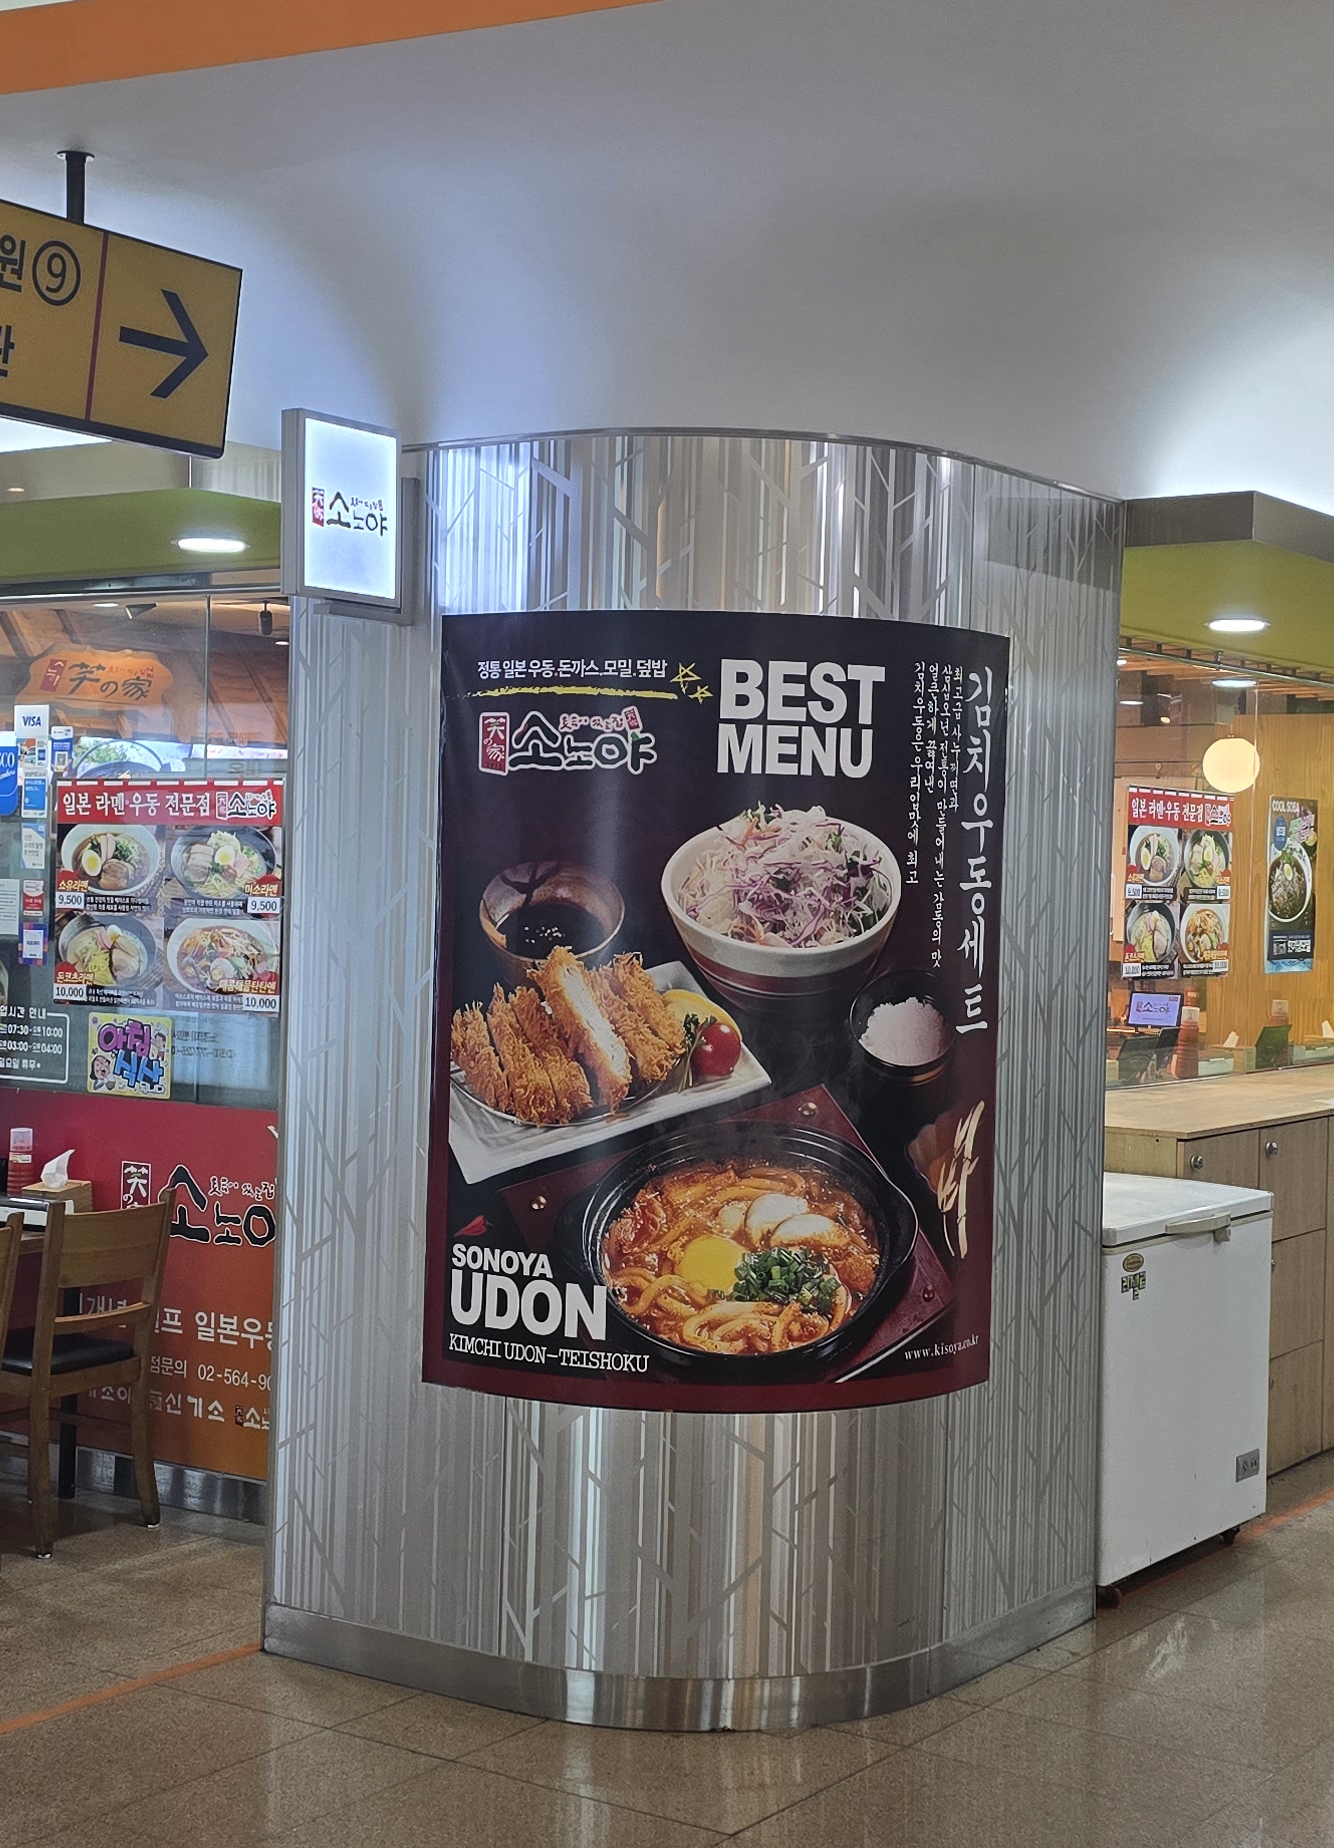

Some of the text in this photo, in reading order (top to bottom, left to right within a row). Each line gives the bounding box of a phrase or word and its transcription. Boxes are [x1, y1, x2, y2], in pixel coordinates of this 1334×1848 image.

[327, 491, 387, 537] 소노야
[478, 660, 501, 678] 정통
[503, 660, 526, 678] 일본
[720, 658, 885, 725] BEST
[22, 716, 41, 727] VISA
[509, 712, 655, 774] 소노야
[717, 723, 873, 779] MENU
[63, 792, 91, 816] 일본
[165, 792, 210, 818] 전문점
[1131, 798, 1147, 819] 일본
[1182, 803, 1203, 822] 전문점
[1272, 800, 1286, 812] COOL
[956, 666, 993, 1035] 김치우동세트
[906, 850, 919, 884] 최고
[58, 895, 82, 905] 9,500
[251, 901, 277, 912] 9,500
[931, 949, 942, 968] 맛
[56, 987, 84, 997] 10,000
[245, 998, 276, 1008] 10,000
[29, 1007, 46, 1019] 안내
[98, 1018, 152, 1057] 아침
[114, 1049, 164, 1088] 식사
[124, 1166, 148, 1209] 笑の
[451, 1243, 552, 1278] SONOYA
[450, 1268, 607, 1341] UDON
[449, 1332, 501, 1358] KIMCHI
